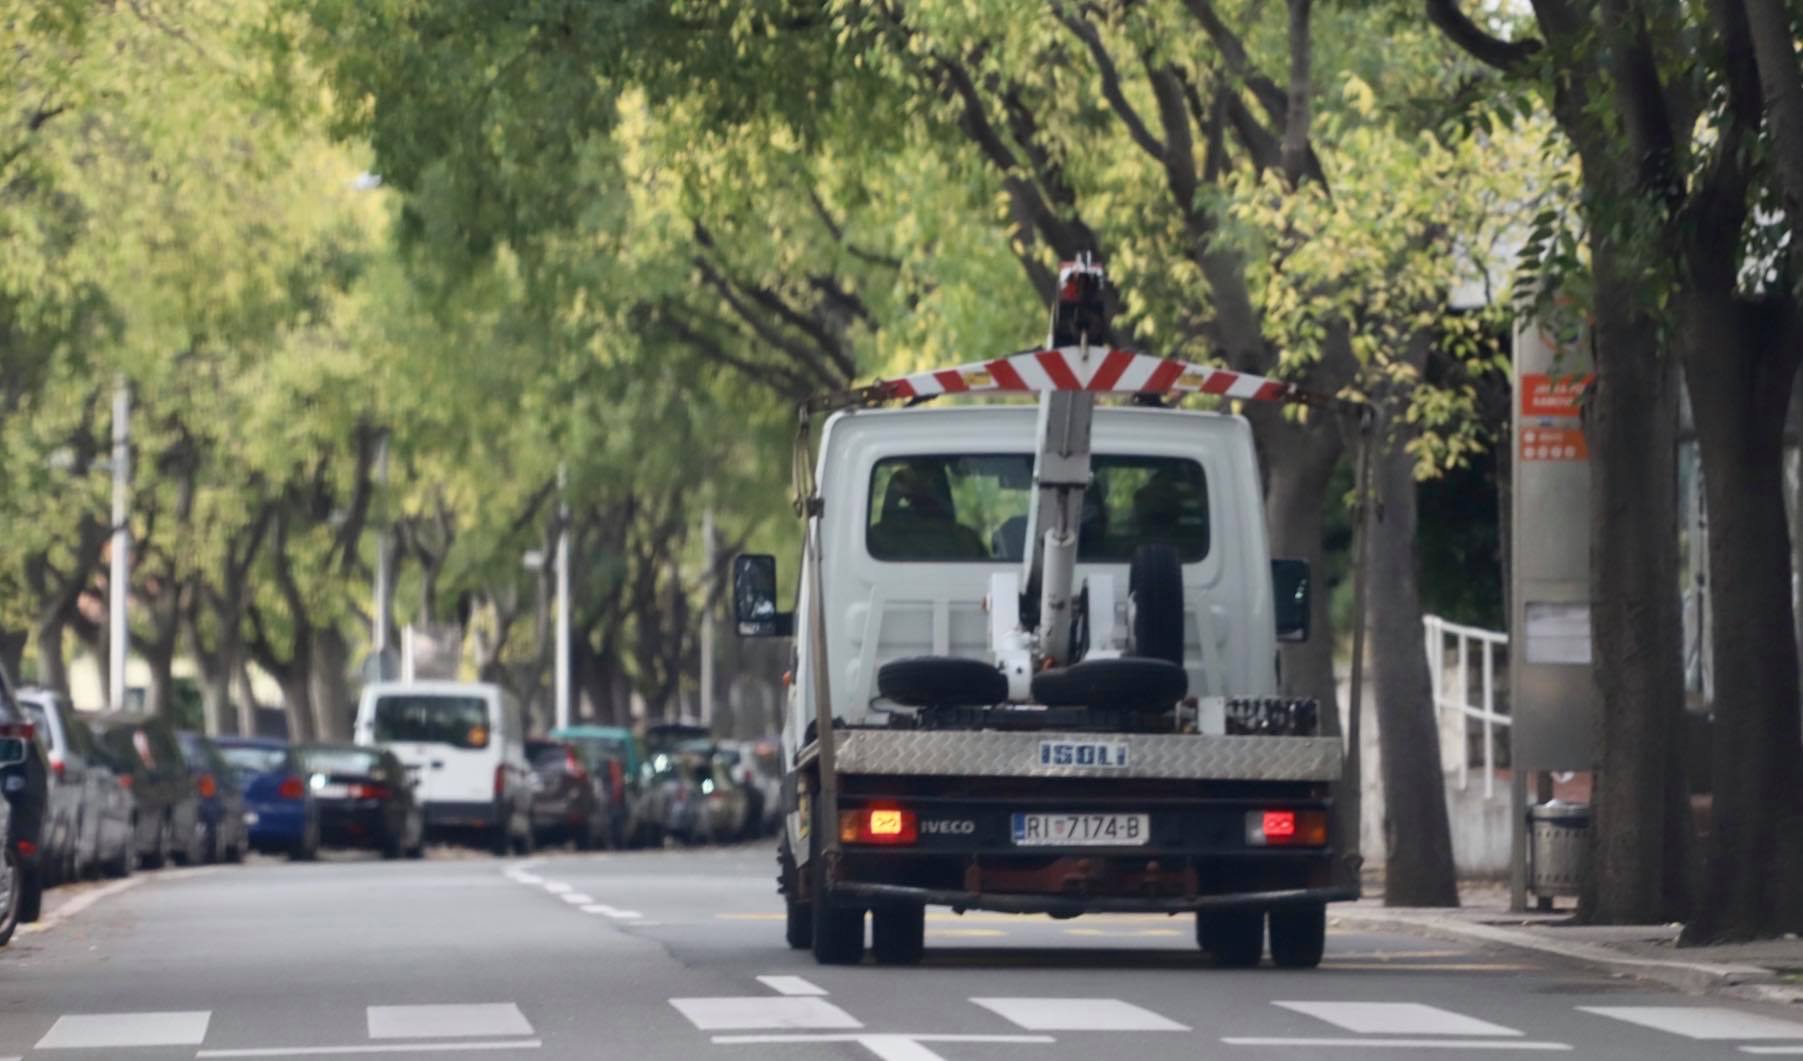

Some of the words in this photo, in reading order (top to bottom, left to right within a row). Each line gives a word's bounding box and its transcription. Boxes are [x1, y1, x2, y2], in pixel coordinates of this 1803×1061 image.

[1041, 744, 1126, 766] ISOLI
[921, 820, 975, 834] IVECO
[1027, 816, 1049, 839] RI
[1067, 816, 1139, 839] 7174-B
